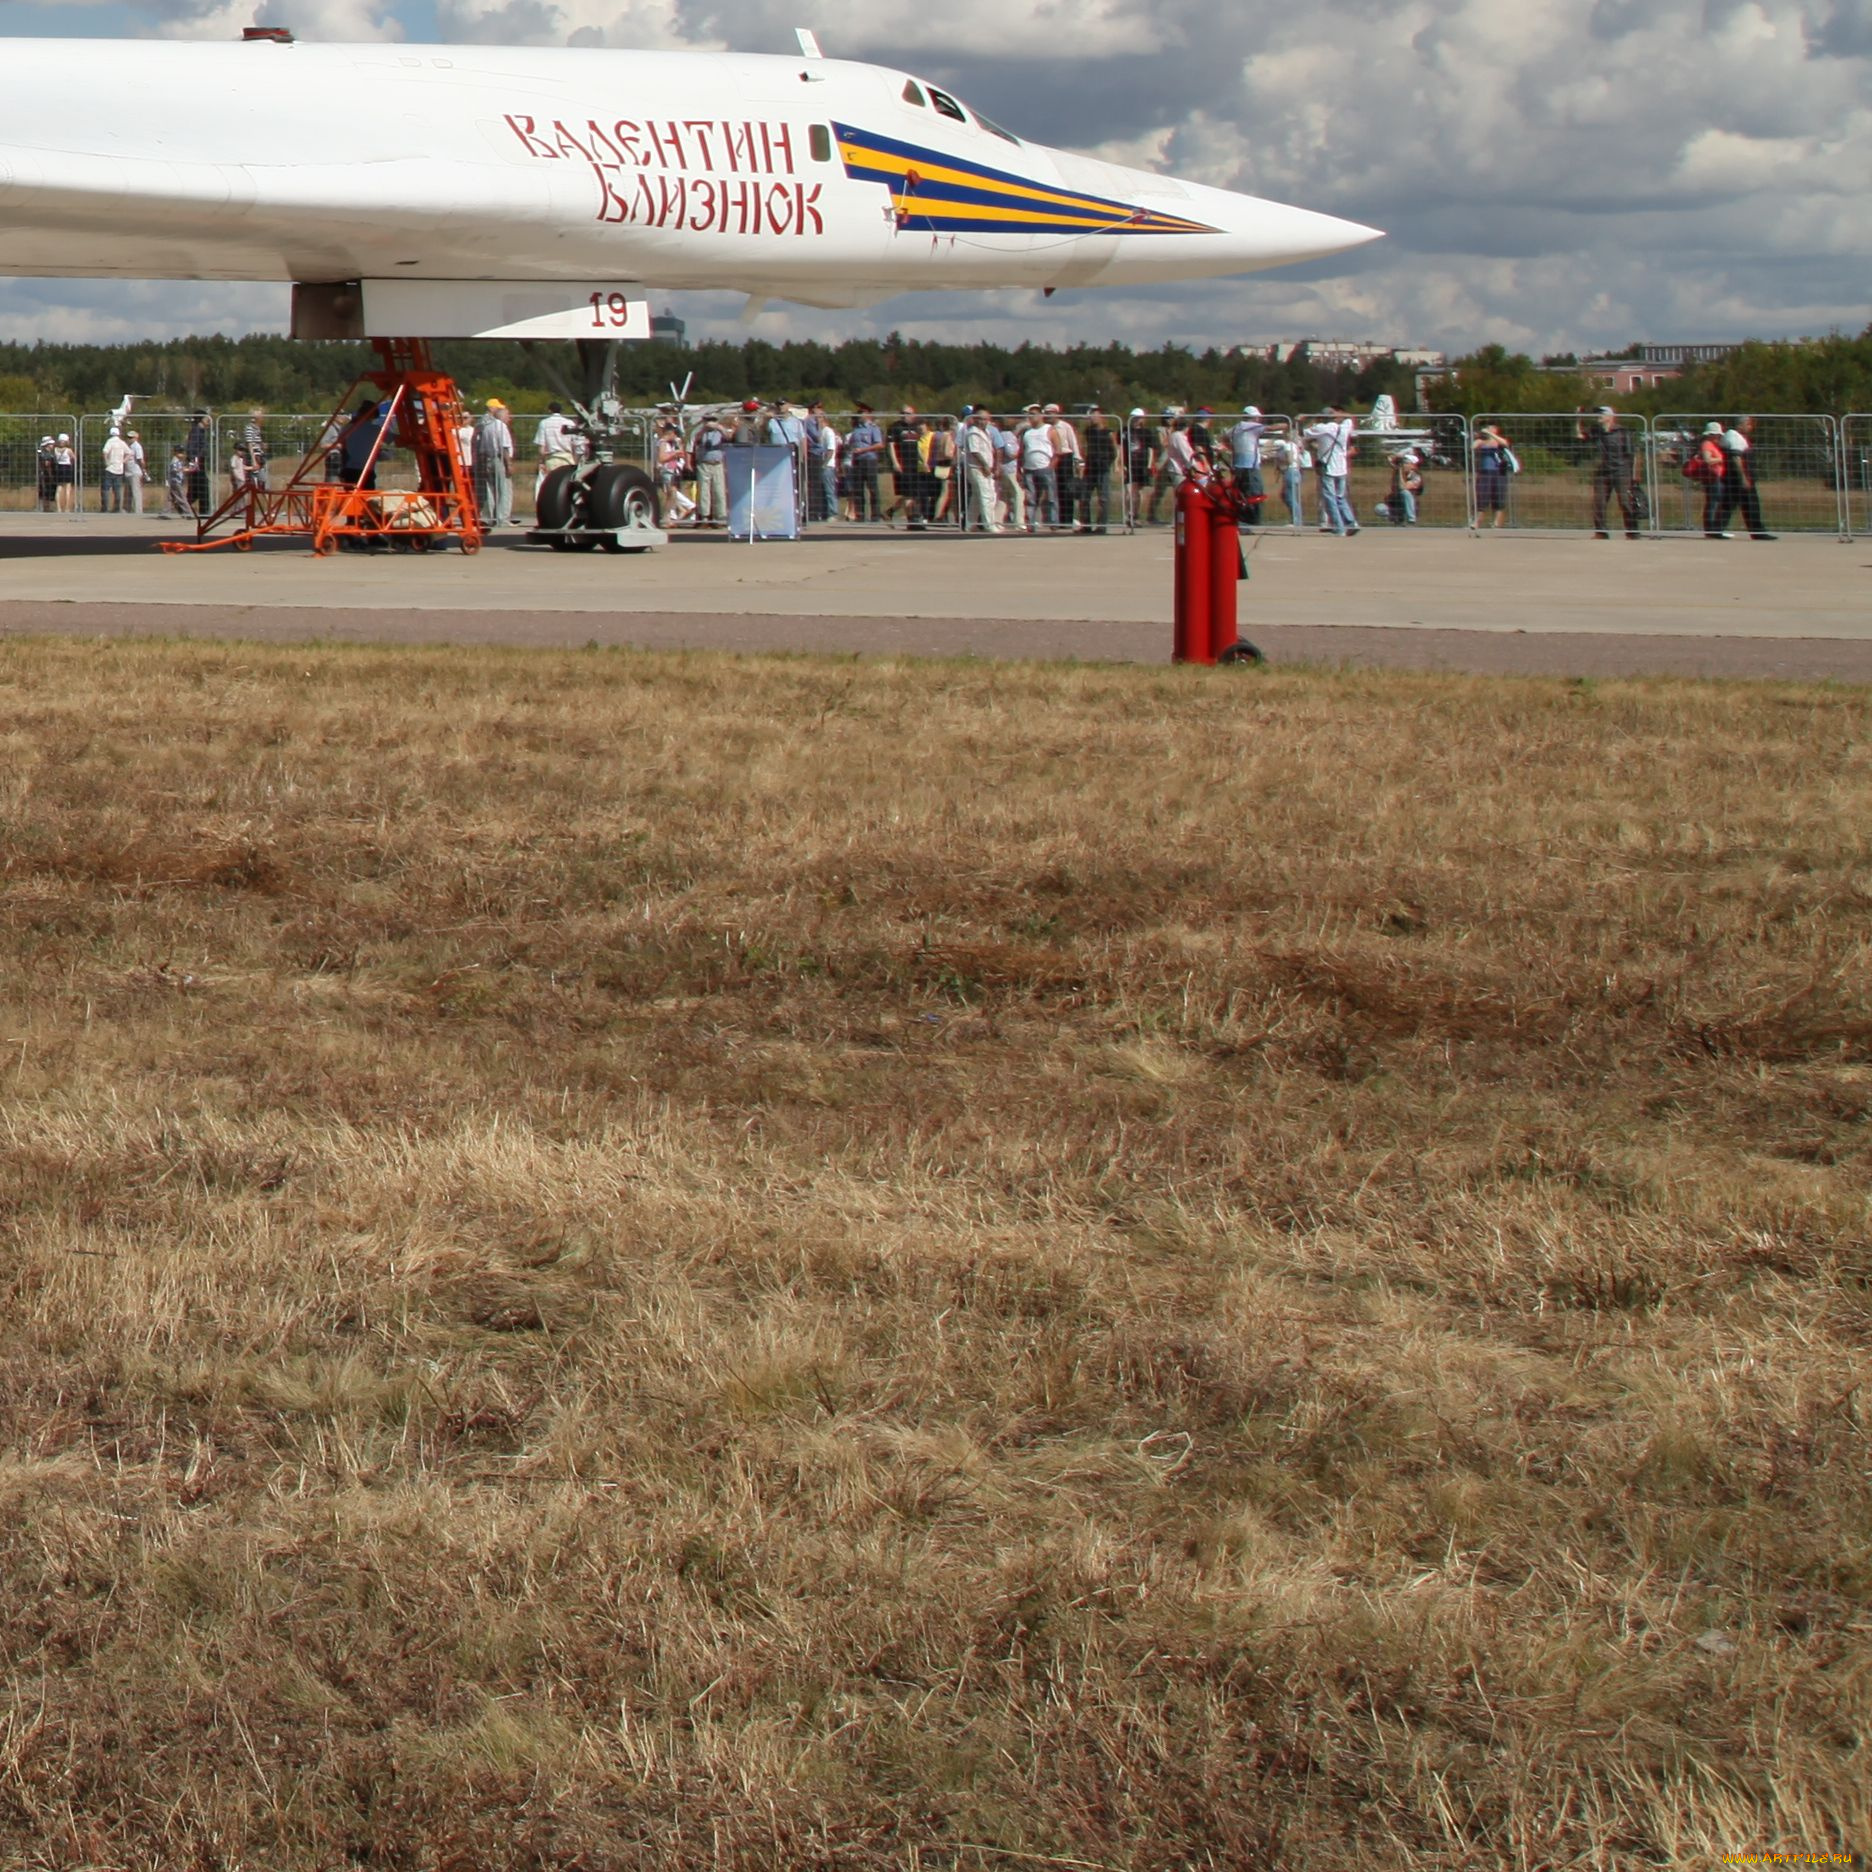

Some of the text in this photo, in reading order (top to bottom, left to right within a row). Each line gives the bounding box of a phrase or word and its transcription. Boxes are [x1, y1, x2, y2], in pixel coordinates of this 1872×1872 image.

[503, 114, 795, 176] ВАЛЕНТИН
[591, 162, 824, 236] БЛИЗНЮК
[589, 292, 628, 328] 19
